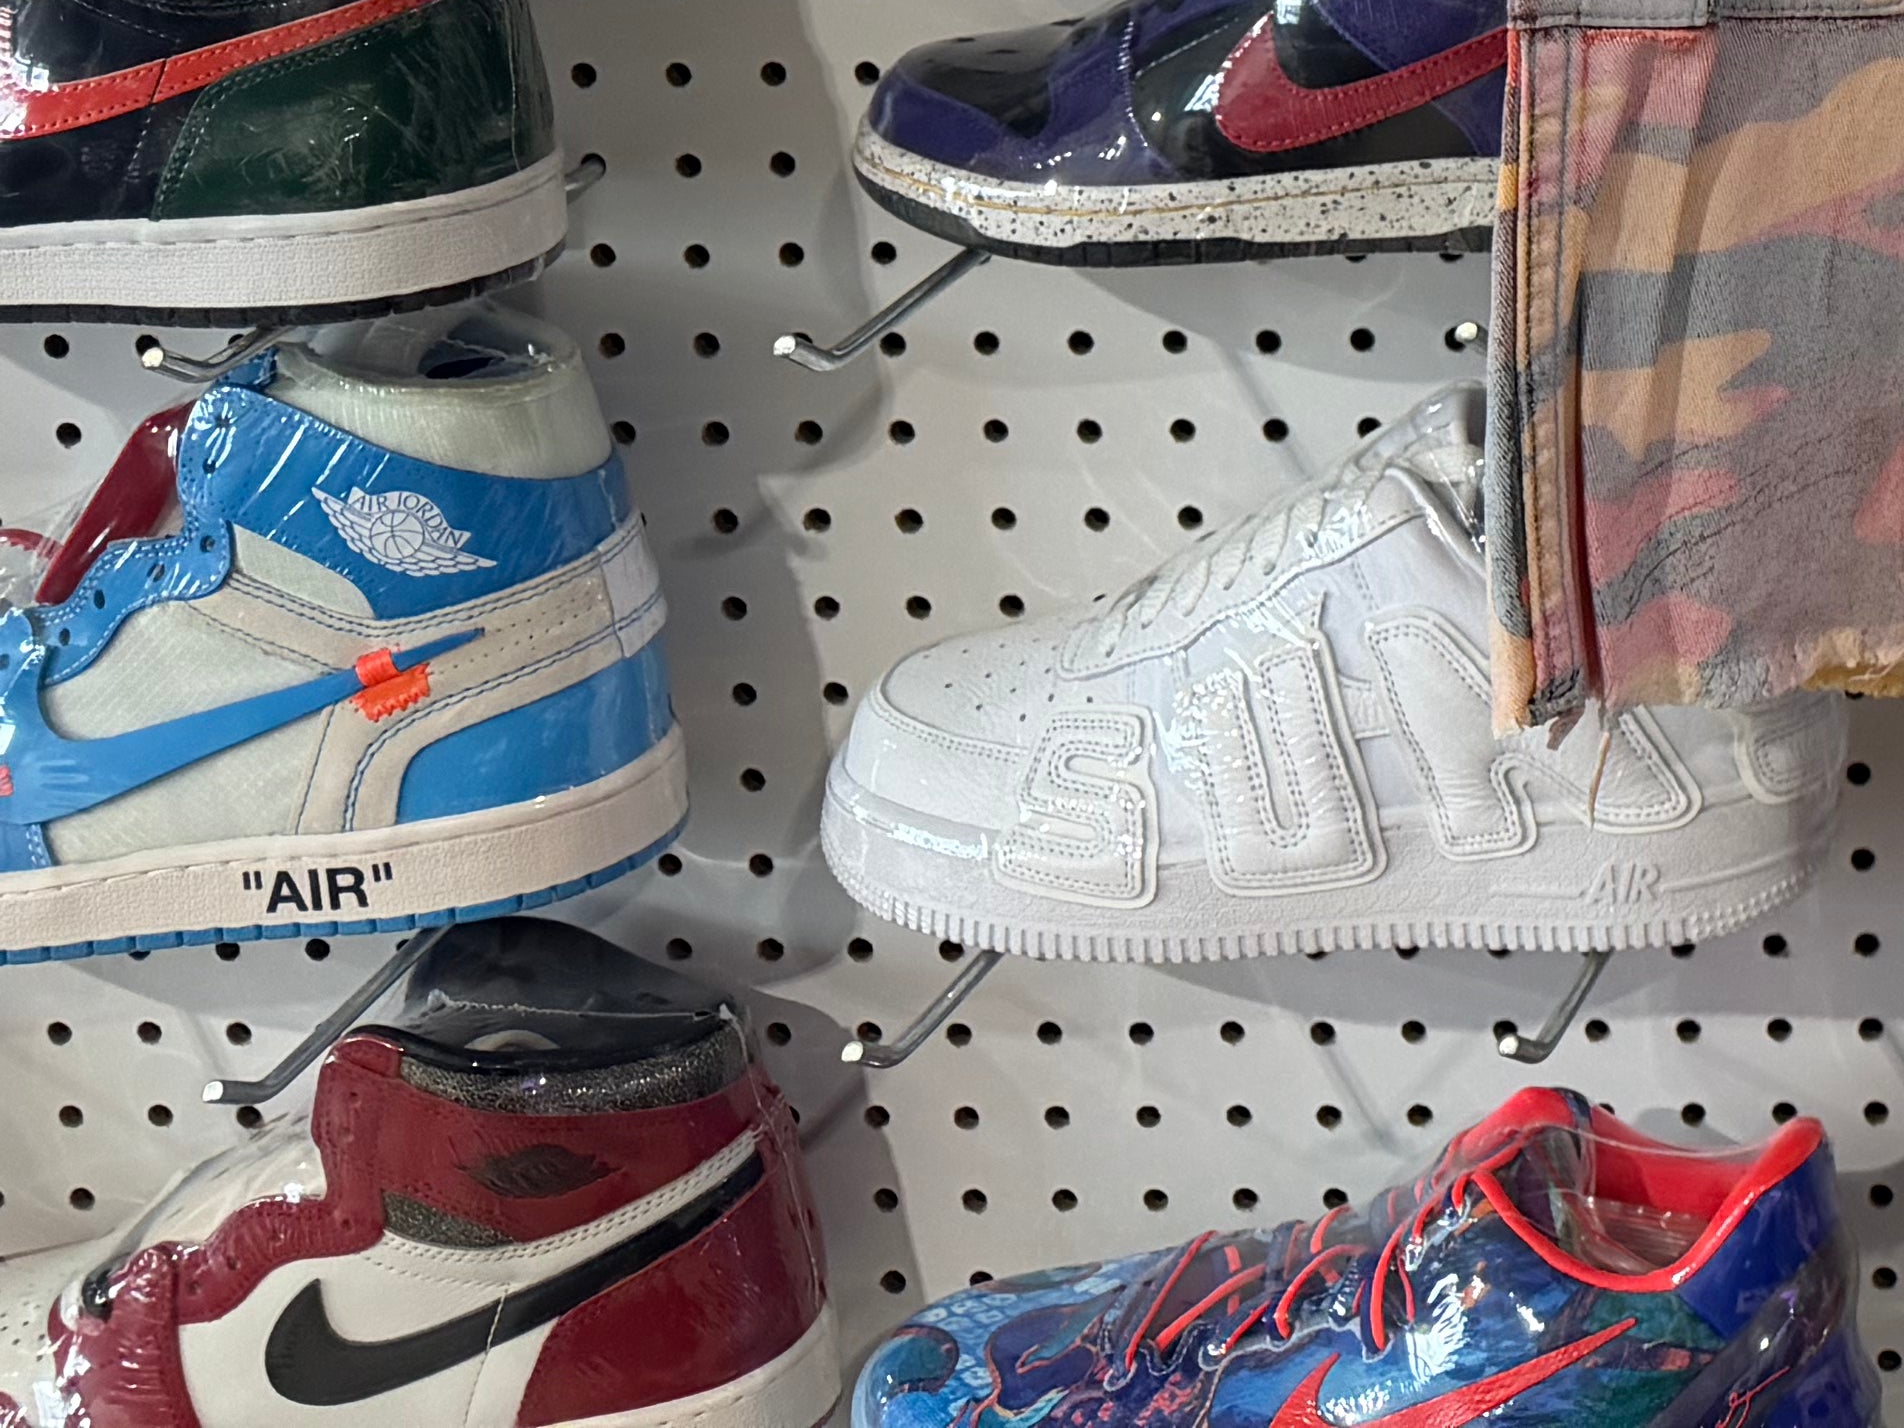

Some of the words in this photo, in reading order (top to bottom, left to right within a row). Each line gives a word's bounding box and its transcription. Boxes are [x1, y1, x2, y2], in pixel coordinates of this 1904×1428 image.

[348, 495, 390, 513] AIR
[396, 491, 466, 549] JORDAN
[242, 861, 394, 914] "AIR"
[1578, 858, 1662, 906] AIR
